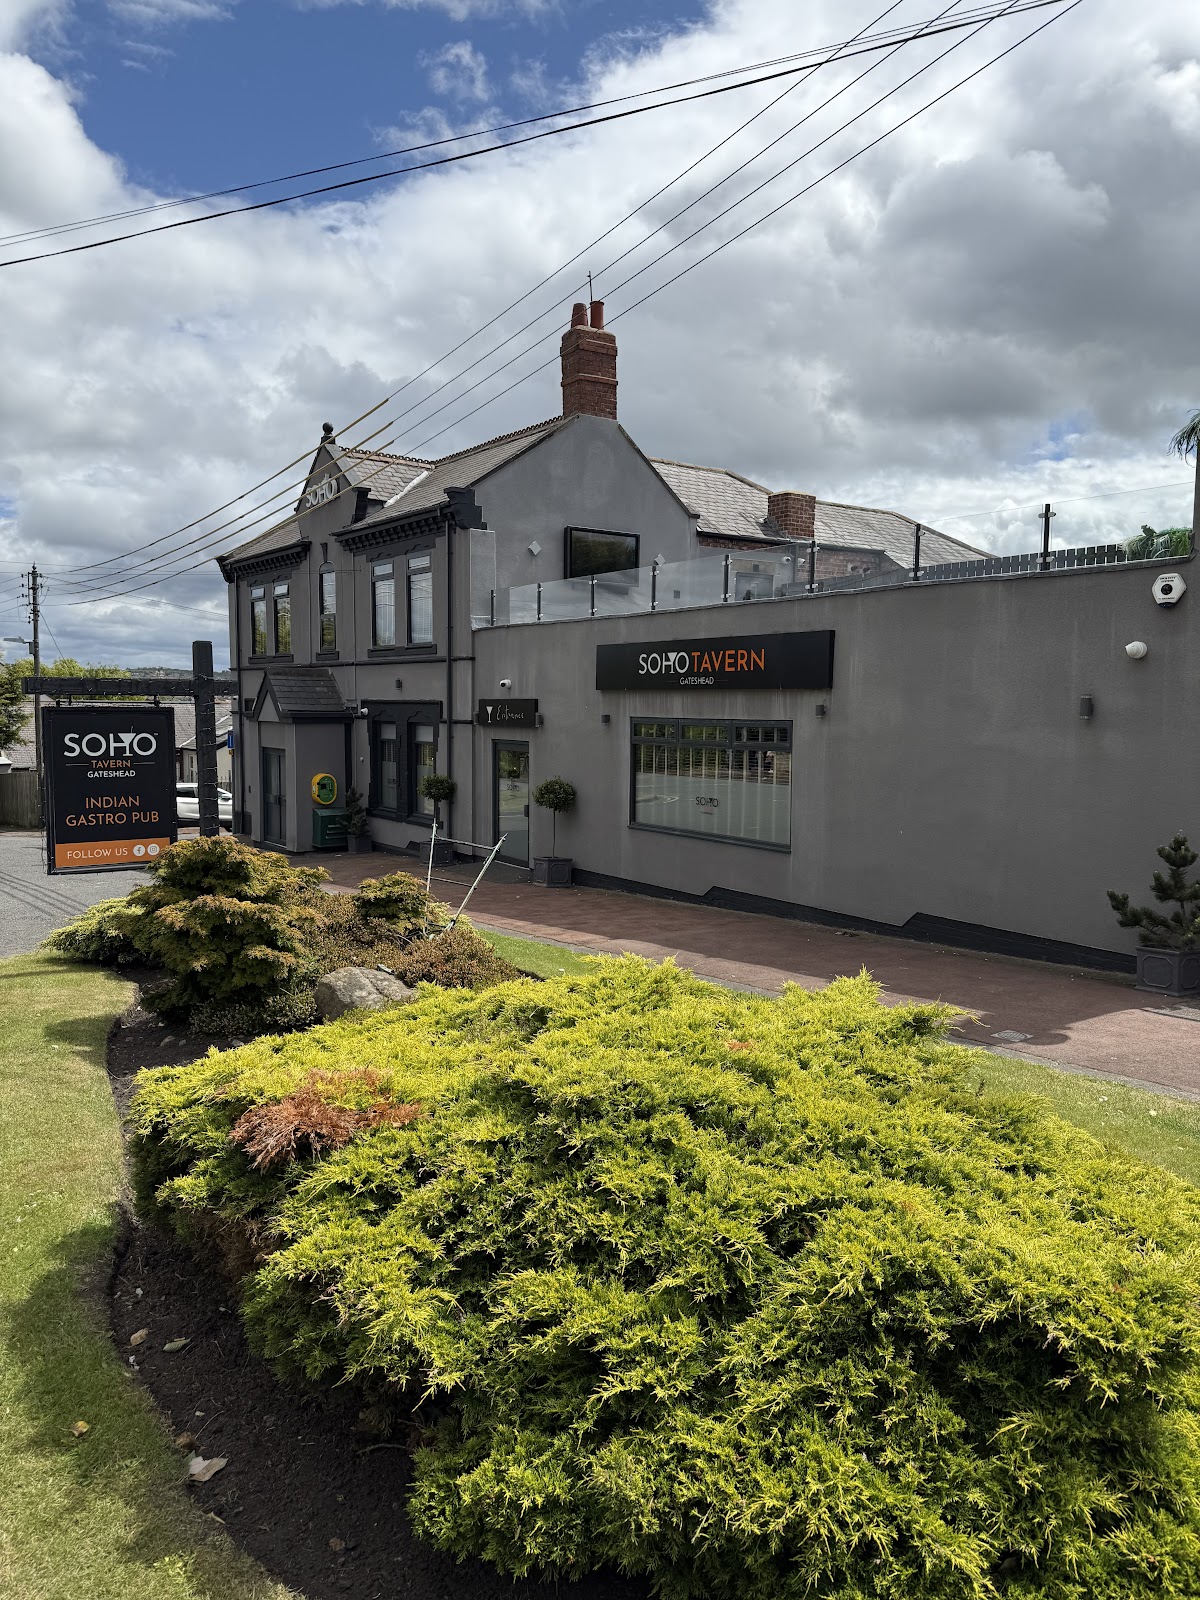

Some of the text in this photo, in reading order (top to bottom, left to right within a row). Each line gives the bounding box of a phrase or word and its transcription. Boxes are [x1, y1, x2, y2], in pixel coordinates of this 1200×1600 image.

[306, 473, 338, 507] SOHO
[639, 649, 765, 674] SOHO TAVERN
[680, 677, 714, 685] GATESHEAD
[64, 733, 157, 757] SOHO
[91, 760, 131, 768] TAVERN
[87, 770, 136, 778] GATESHEAD
[85, 796, 140, 808] INDIAN
[695, 796, 719, 807] SOHO
[65, 811, 159, 826] GASTRO PUB
[67, 848, 128, 859] FOLLOW US
